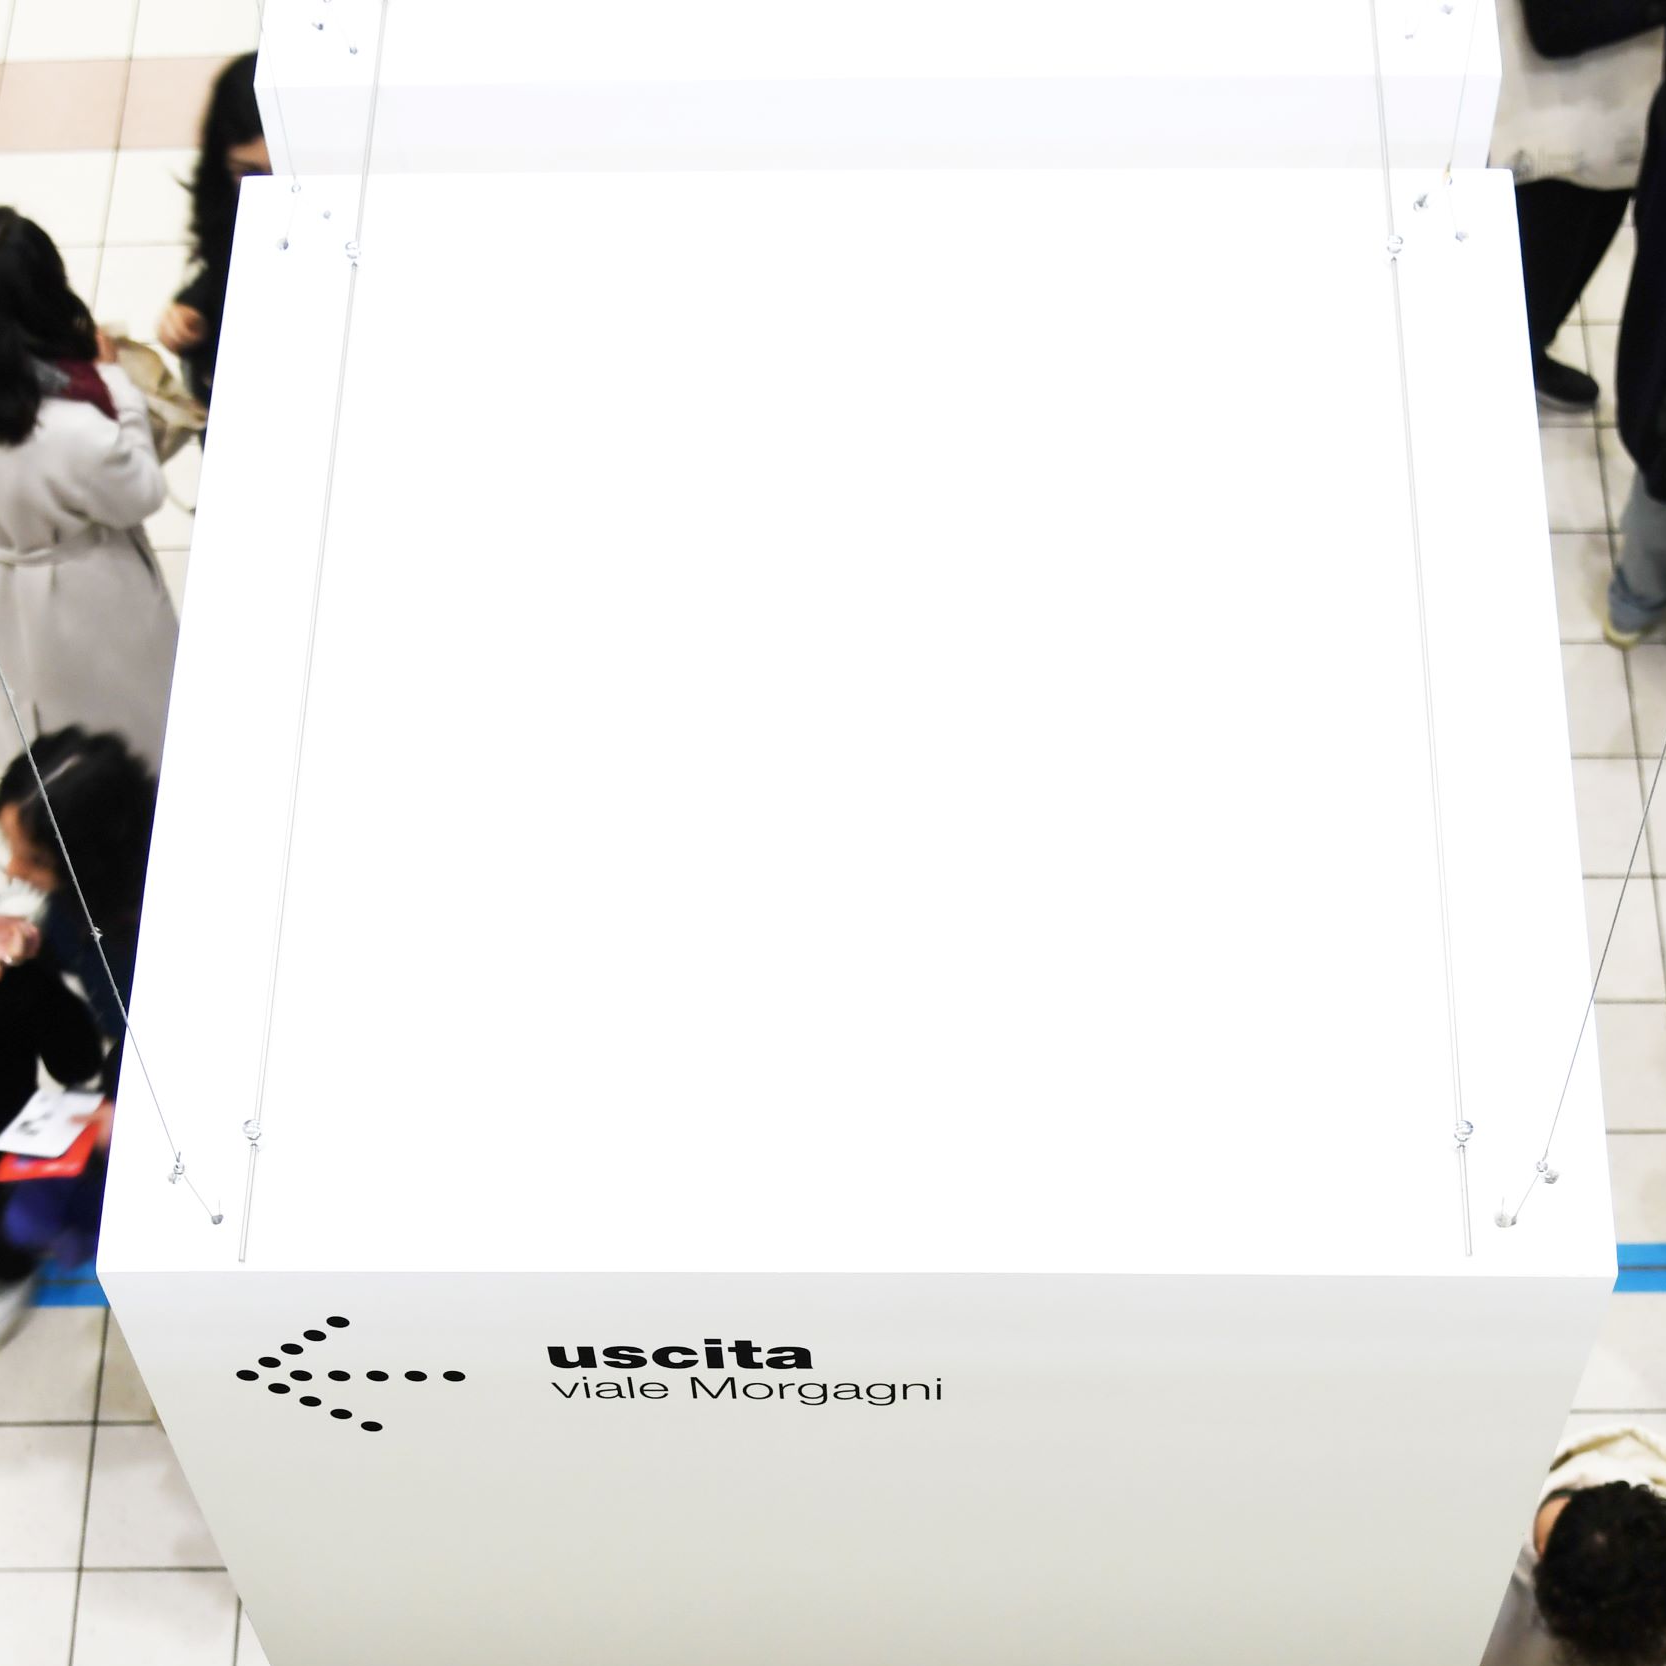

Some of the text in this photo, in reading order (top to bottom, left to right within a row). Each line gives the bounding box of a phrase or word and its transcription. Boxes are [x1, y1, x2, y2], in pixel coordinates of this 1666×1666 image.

[546, 1338, 813, 1370] uscita
[551, 1376, 942, 1407] viale Morgagni
